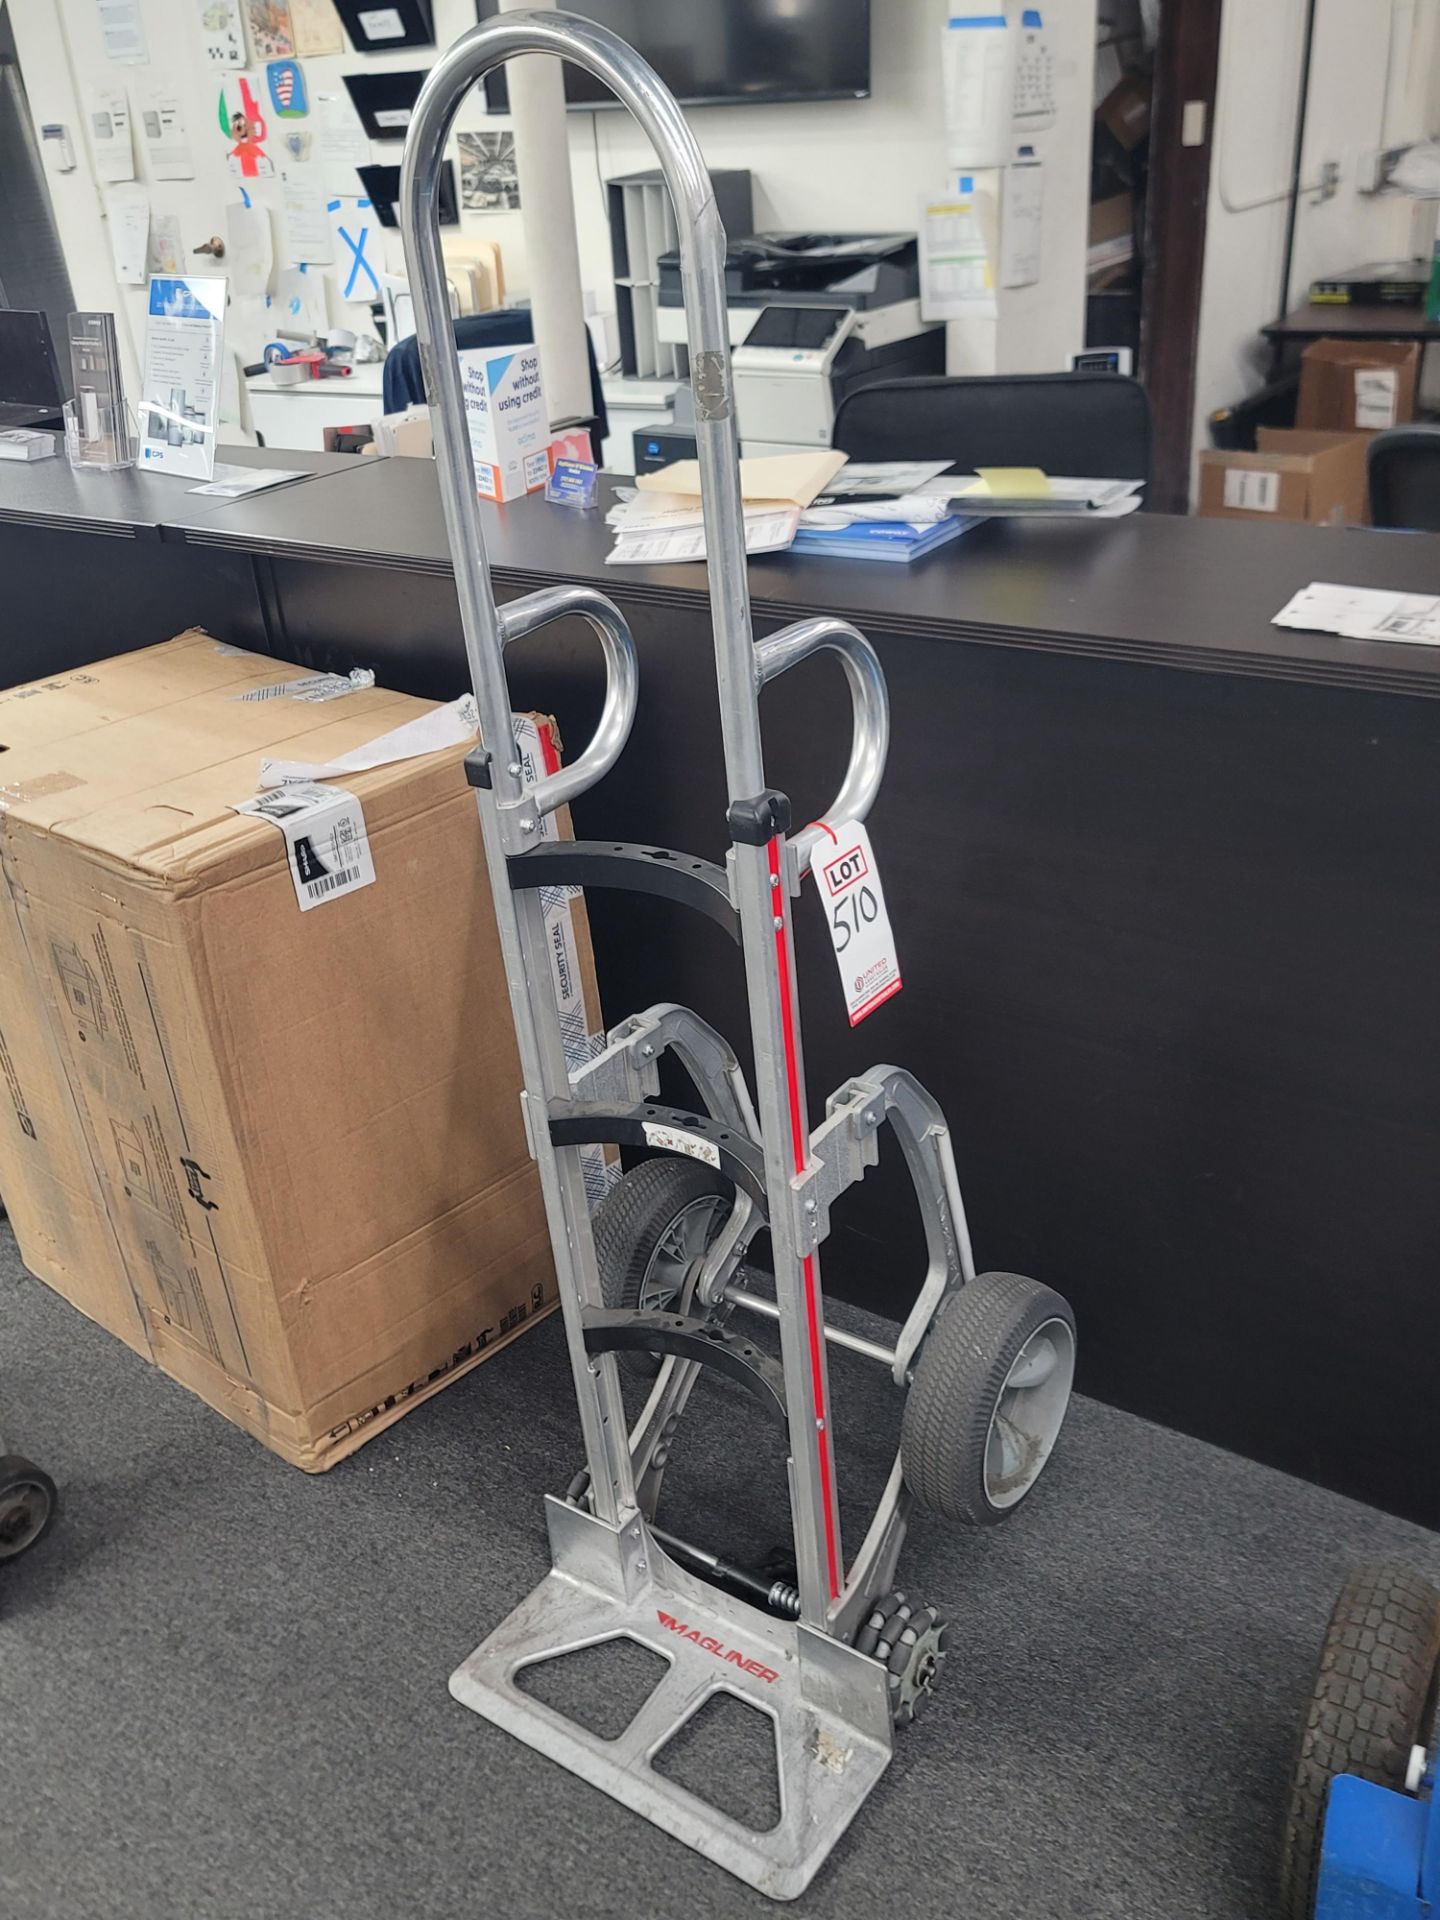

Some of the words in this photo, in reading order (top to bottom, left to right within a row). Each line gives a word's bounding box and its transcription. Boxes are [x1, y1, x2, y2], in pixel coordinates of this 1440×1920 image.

[468, 366, 484, 383] Shop
[521, 358, 538, 372] Shop
[512, 372, 539, 390] without
[470, 399, 488, 412] credit
[498, 396, 521, 411] using
[522, 385, 542, 403] credit
[522, 753, 534, 783] SEAL
[829, 854, 862, 887] LOT
[833, 885, 878, 953] 510
[552, 922, 562, 950] SEAL
[555, 952, 570, 1000] SECURITY
[662, 1613, 780, 1684] MAGLINER
